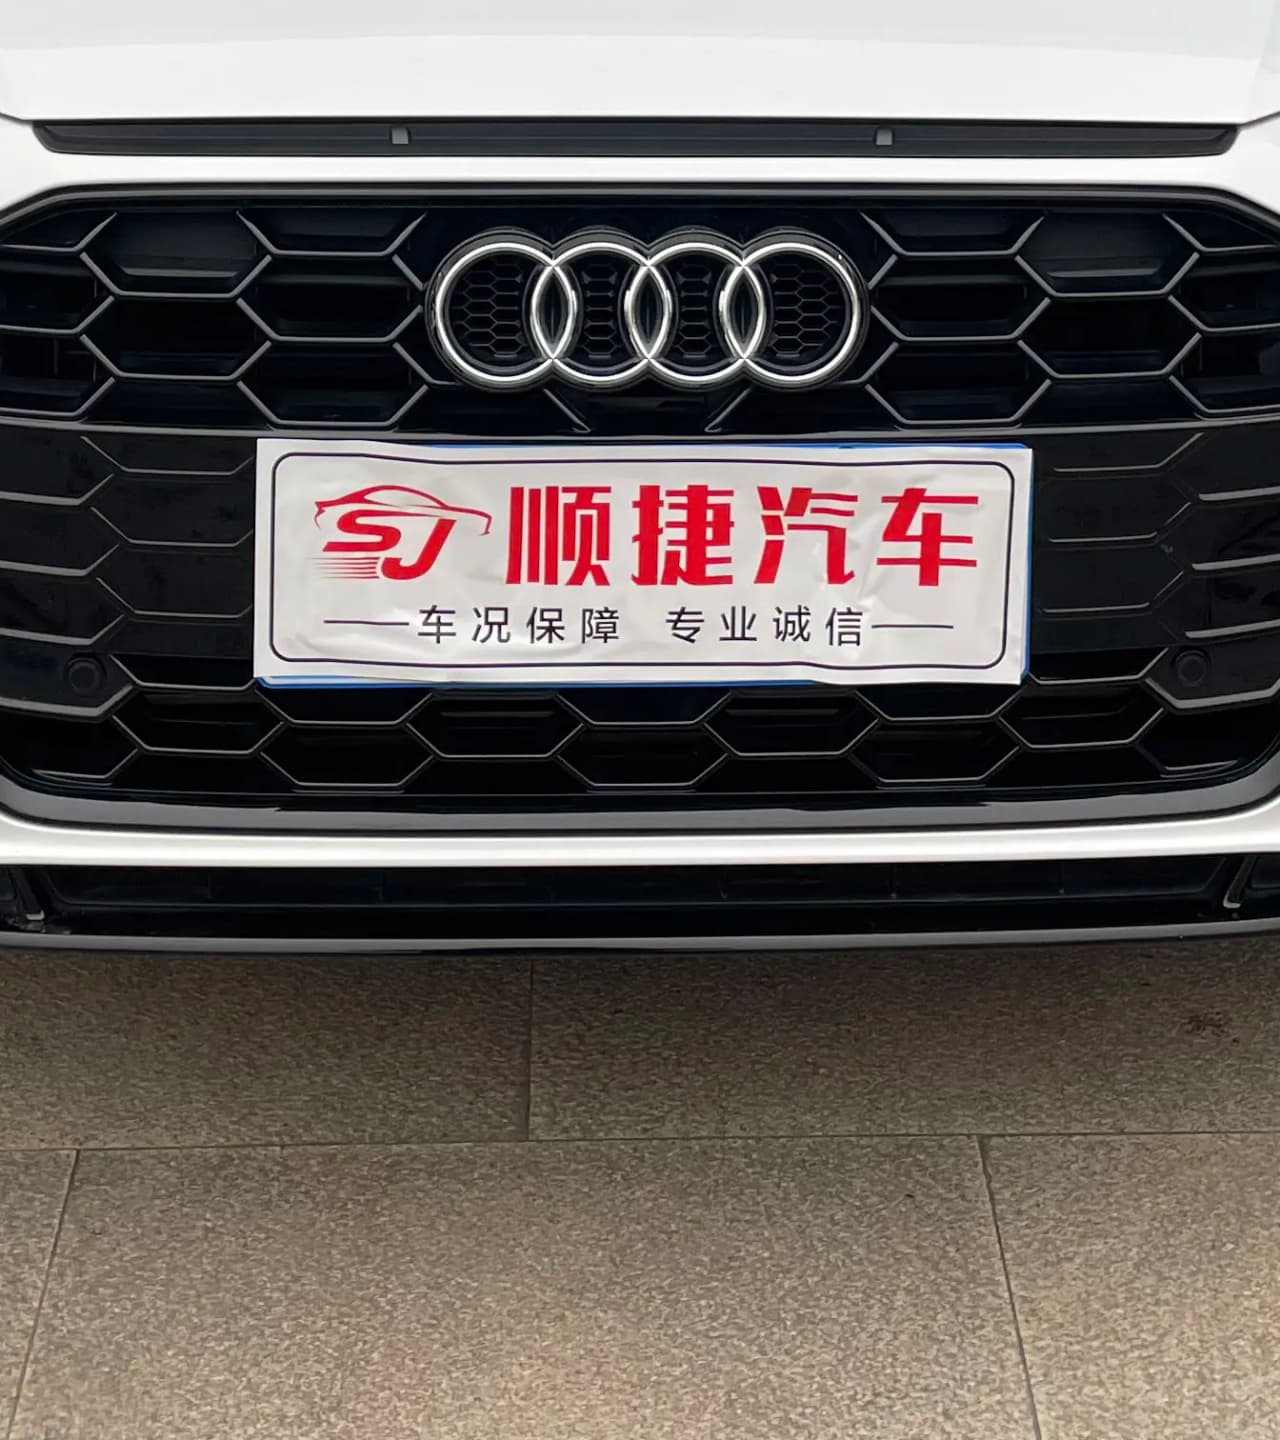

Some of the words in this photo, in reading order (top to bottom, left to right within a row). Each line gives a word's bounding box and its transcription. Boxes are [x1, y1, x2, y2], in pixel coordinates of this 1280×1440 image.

[505, 484, 981, 588] 顺捷汽车
[417, 605, 622, 645] 车况保障
[665, 607, 866, 648] 专业诚信
